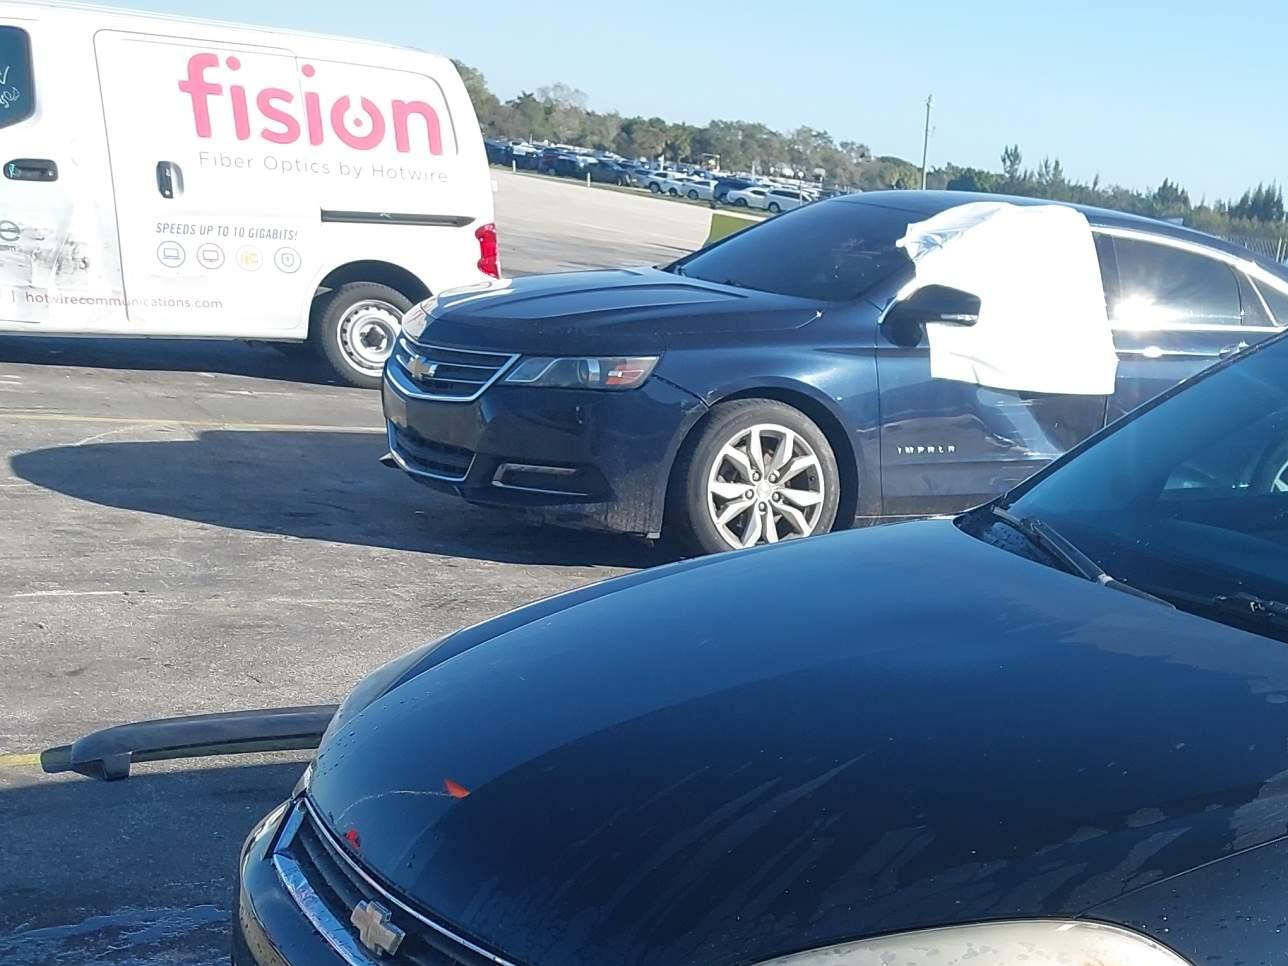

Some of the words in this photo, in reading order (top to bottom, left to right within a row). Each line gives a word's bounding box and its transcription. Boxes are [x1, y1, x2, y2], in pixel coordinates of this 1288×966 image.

[178, 53, 443, 156] fision
[199, 152, 254, 169] Fiber
[263, 155, 330, 175] Optics
[339, 162, 362, 179] by
[372, 165, 448, 183] Hotwire
[156, 222, 197, 236] SPEEDS
[199, 225, 214, 236] UP
[217, 226, 229, 237] TO
[234, 226, 245, 238] 10
[248, 228, 298, 241] GIGABITS!
